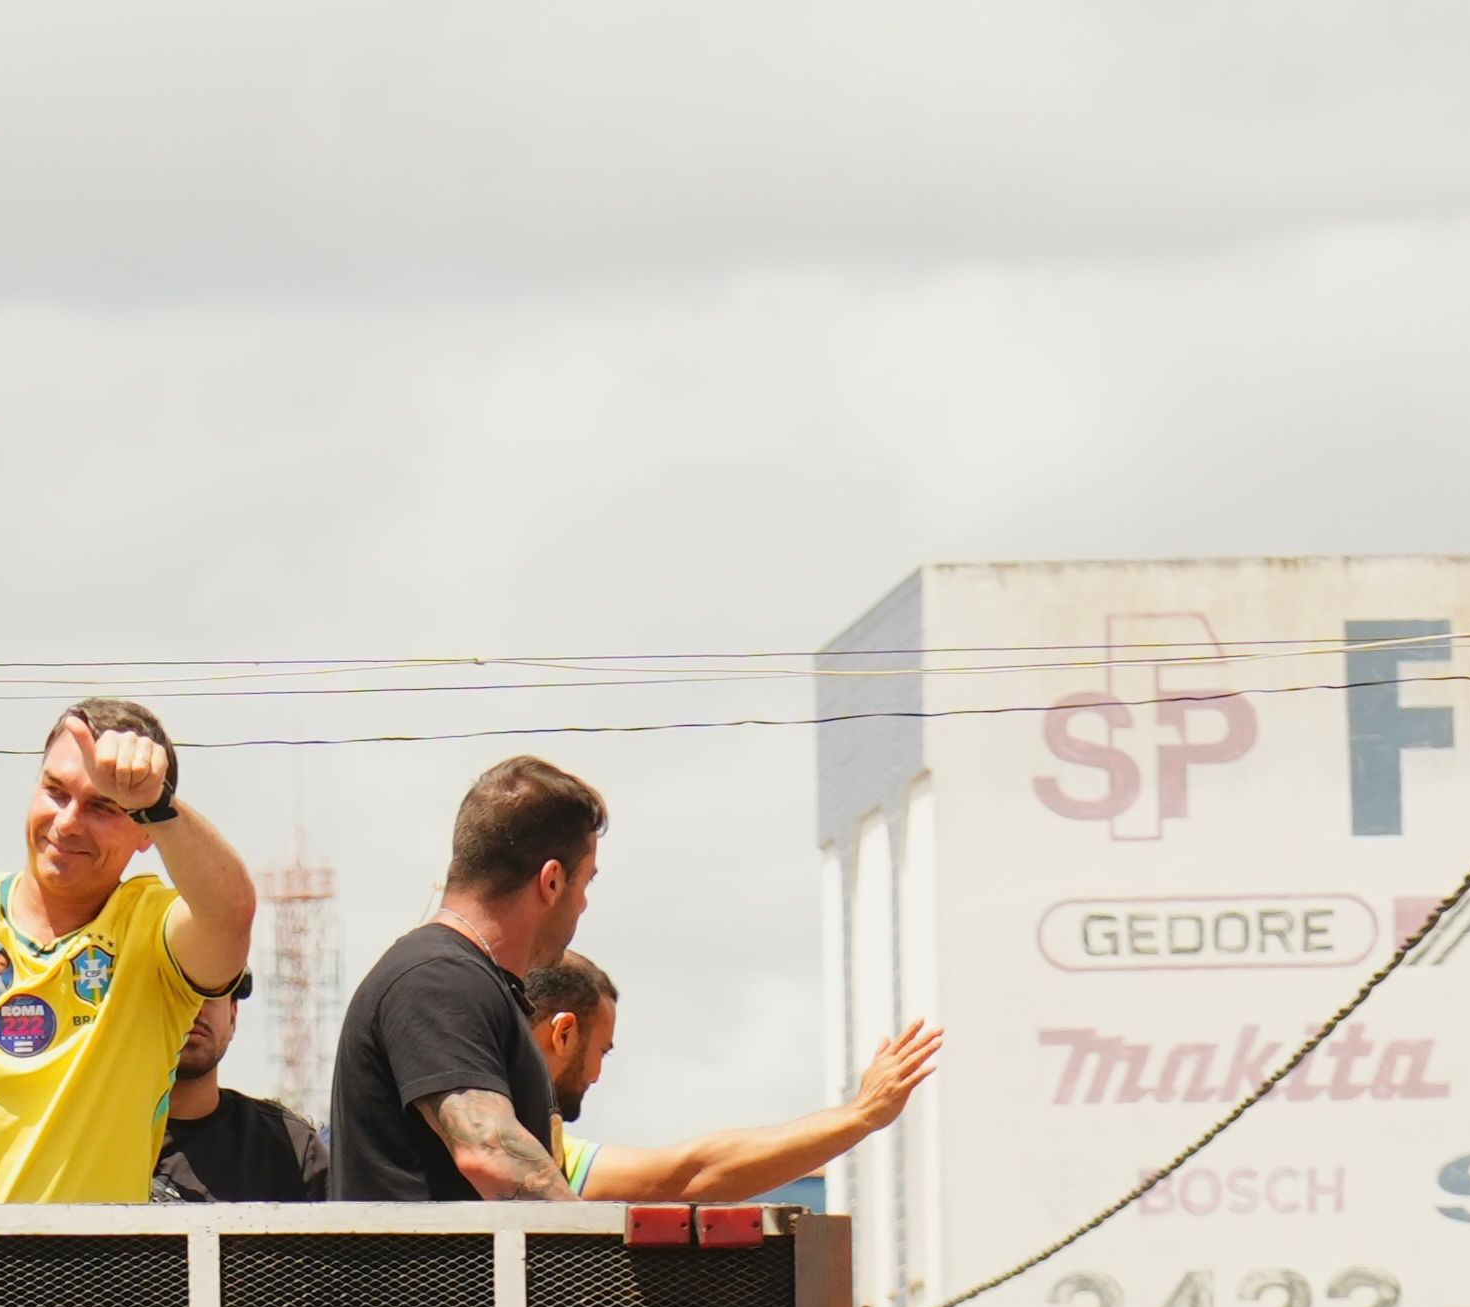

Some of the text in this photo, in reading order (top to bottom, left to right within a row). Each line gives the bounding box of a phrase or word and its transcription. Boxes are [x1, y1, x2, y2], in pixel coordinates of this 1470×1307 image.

[1032, 688, 1259, 823] SP
[1082, 909, 1335, 957] GEDORE
[0, 1004, 45, 1018] ROMA
[2, 1016, 45, 1037] 222
[1136, 1164, 1346, 1216] BOSCH
